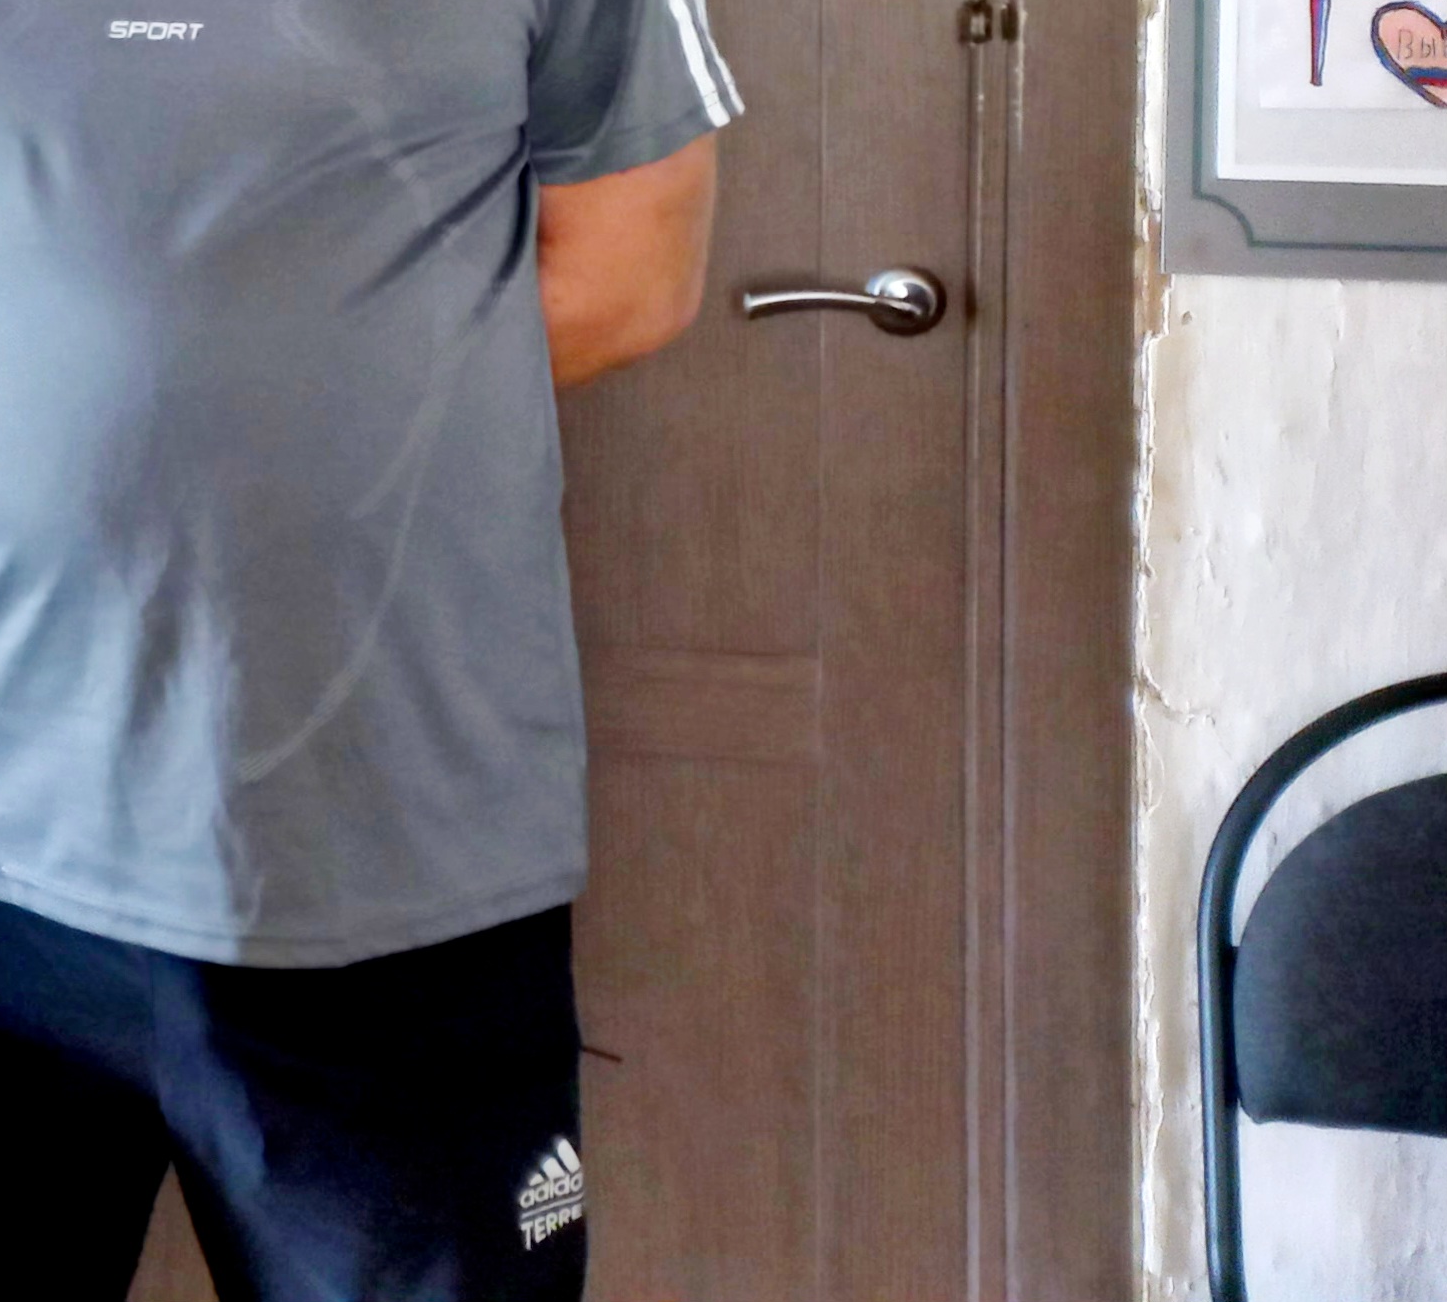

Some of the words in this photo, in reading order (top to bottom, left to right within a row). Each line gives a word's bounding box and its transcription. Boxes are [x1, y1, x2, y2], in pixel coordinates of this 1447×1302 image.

[108, 20, 204, 41] SPORT
[519, 1173, 584, 1209] adida
[520, 1203, 584, 1251] TERRE
